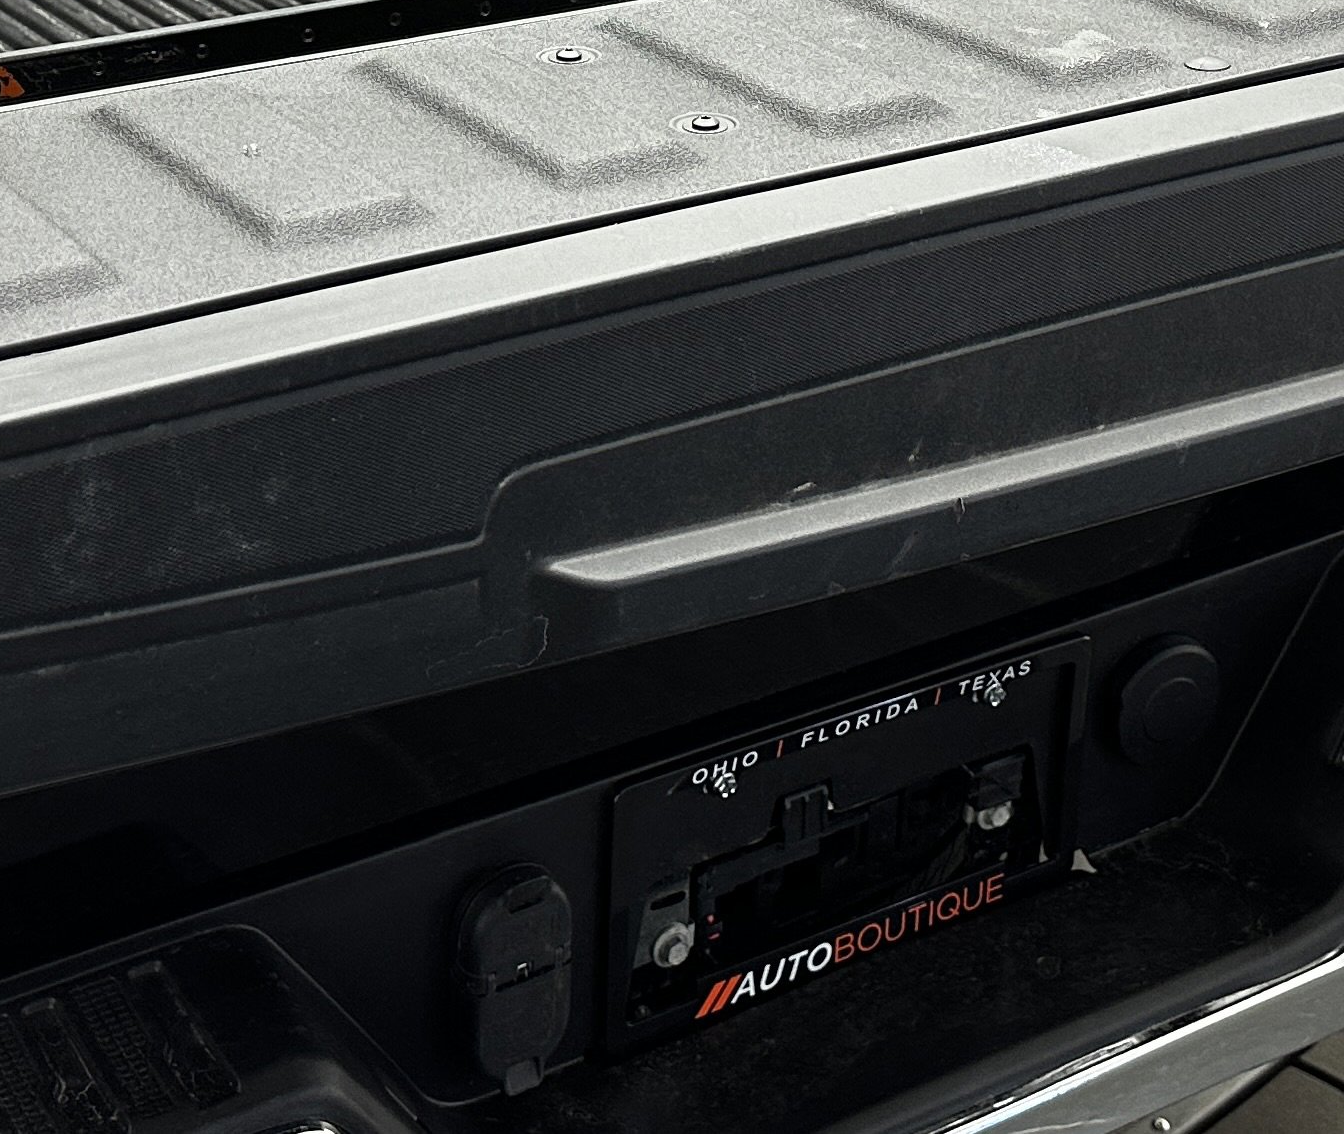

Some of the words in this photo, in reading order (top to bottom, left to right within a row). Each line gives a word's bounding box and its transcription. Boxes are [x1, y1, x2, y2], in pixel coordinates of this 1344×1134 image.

[692, 750, 758, 785] OHIO
[800, 697, 919, 748] FLORIDA
[959, 660, 1031, 696] TEXAS
